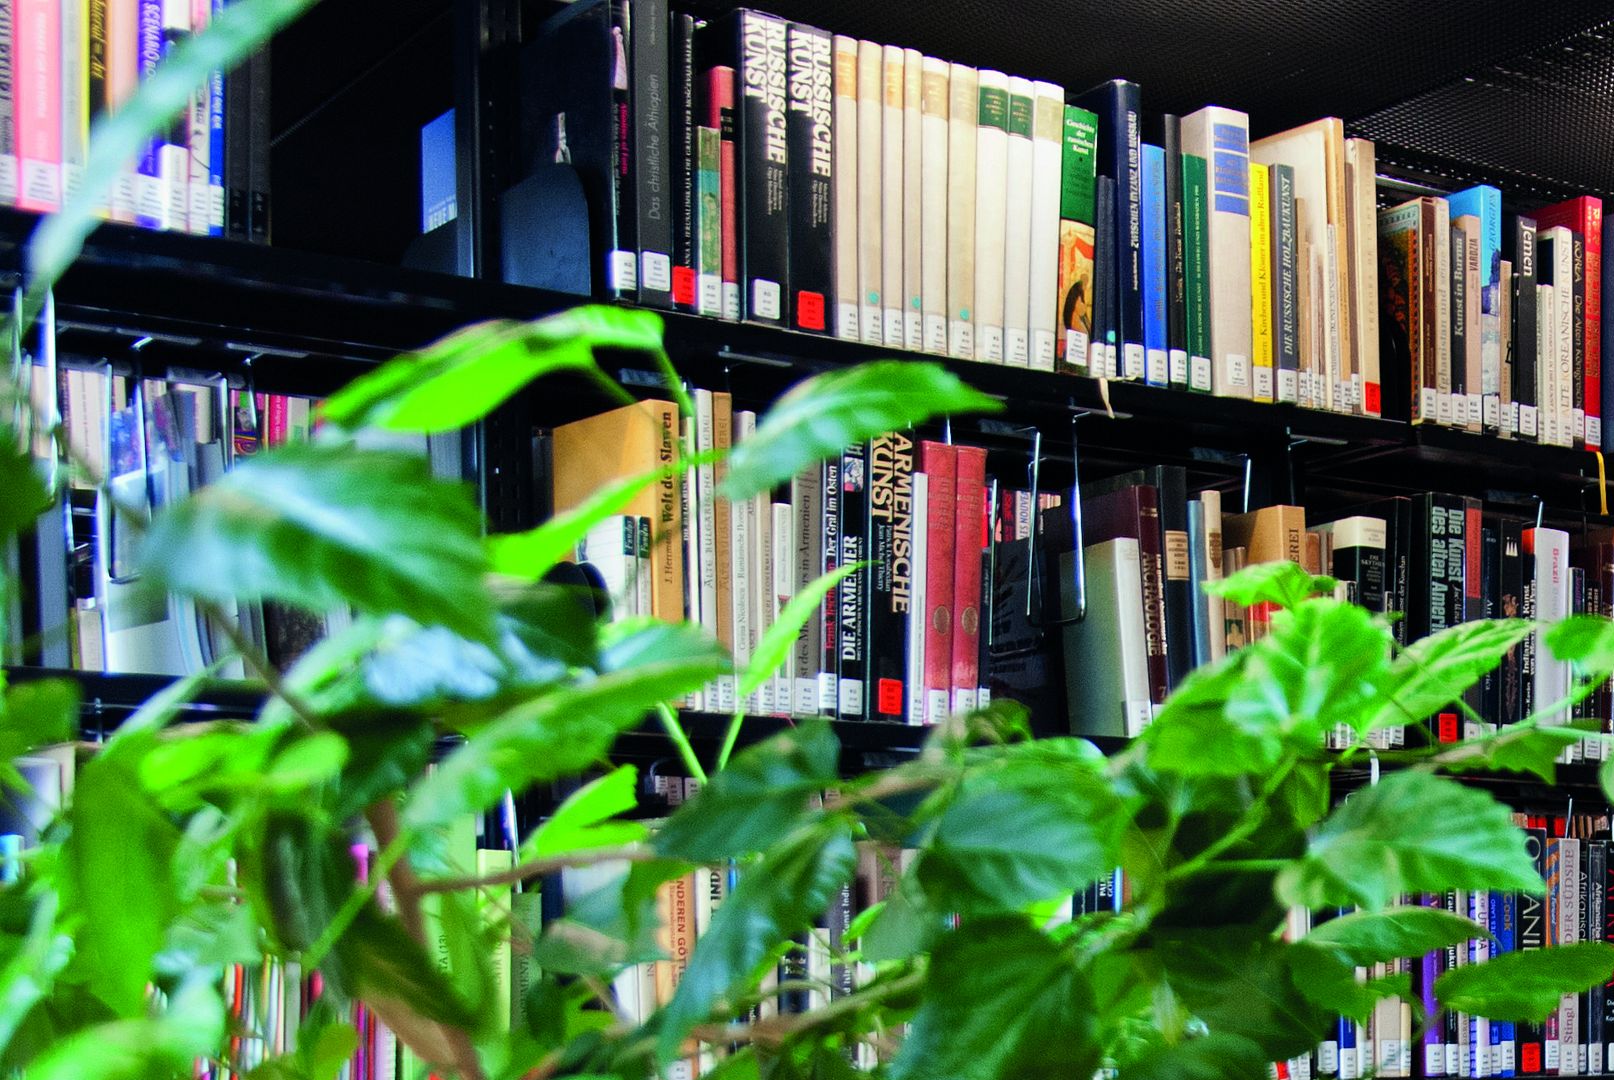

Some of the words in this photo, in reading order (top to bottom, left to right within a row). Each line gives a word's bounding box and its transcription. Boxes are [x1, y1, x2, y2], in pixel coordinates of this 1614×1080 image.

[744, 14, 767, 103] KUNST
[790, 28, 813, 118] KUNST
[645, 74, 662, 132] Äthiopien
[766, 21, 787, 165] RUSSISCHE
[812, 33, 832, 178] RUSSISCHE
[646, 135, 661, 193] christliche
[647, 197, 661, 220] Das
[1129, 202, 1139, 248] ZWISCHEN
[1280, 174, 1292, 269] HOLZBAUKUNST
[1453, 237, 1464, 281] Burma
[1520, 221, 1536, 277] Jemen
[1574, 240, 1583, 282] KOREA
[1258, 281, 1267, 299] und
[1282, 270, 1293, 332] RUSSISCHE
[1453, 283, 1463, 296] in
[1574, 295, 1583, 312] Die
[1453, 298, 1464, 336] Kunst
[1574, 316, 1583, 343] Alten
[1283, 334, 1294, 355] DIE
[1437, 319, 1449, 394] fghanistan
[661, 466, 673, 489] de
[825, 465, 837, 494] Osten
[661, 492, 673, 523] Welt
[825, 496, 836, 510] im
[1431, 506, 1448, 534] des
[798, 495, 810, 556] Armenien
[825, 511, 837, 535] Gral
[892, 431, 913, 615] ARMENISCHE
[1448, 509, 1465, 537] Die
[825, 538, 837, 556] Der
[1431, 539, 1448, 577] alten
[1448, 538, 1464, 582] Kunst
[1552, 548, 1560, 584] Brazil
[798, 643, 809, 663] des
[842, 632, 856, 661] DIE
[1562, 849, 1575, 909] SÜDSEE
[1562, 913, 1575, 944] DER
[1563, 1006, 1576, 1044] Stingl
